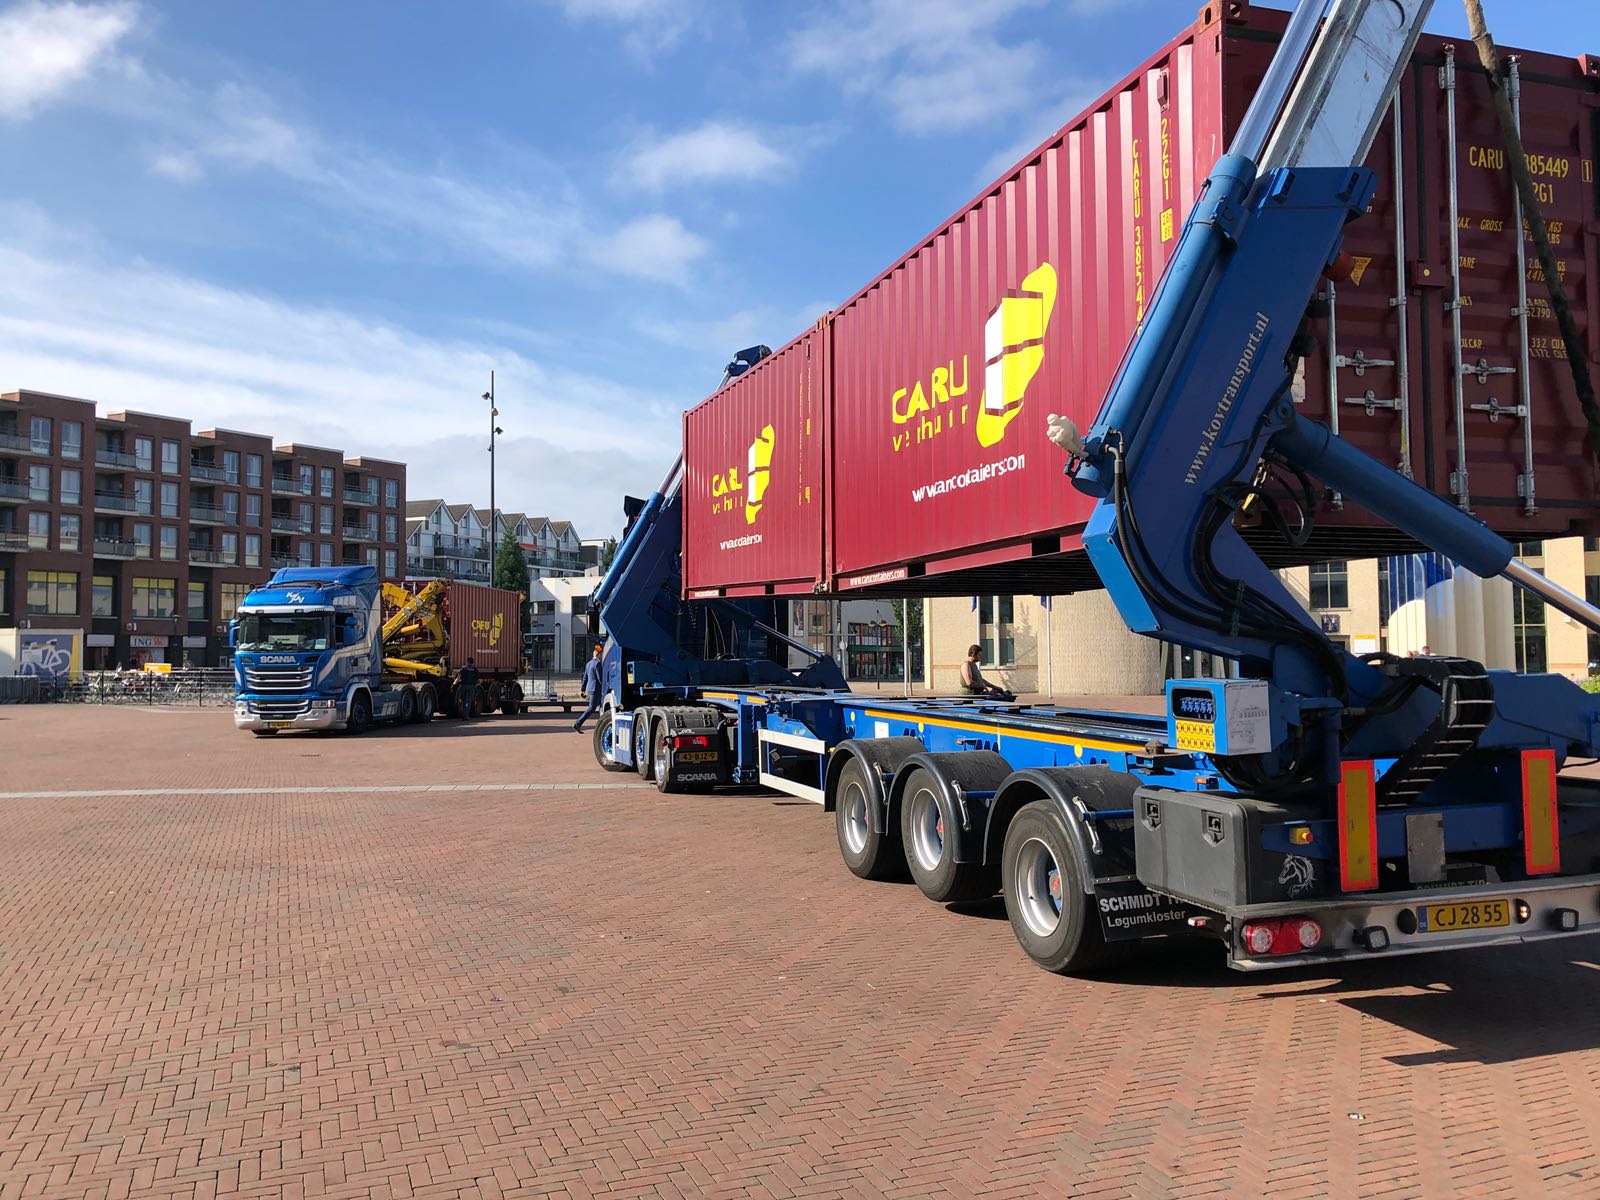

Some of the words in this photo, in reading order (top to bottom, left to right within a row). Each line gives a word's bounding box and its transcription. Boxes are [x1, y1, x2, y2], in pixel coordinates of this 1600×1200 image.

[1468, 146, 1504, 170] CARU
[1133, 138, 1142, 218] CARU
[1479, 219, 1504, 232] GROSS
[1548, 221, 1564, 233] KGS
[1556, 261, 1566, 272] GS
[892, 353, 968, 424] CARU
[1184, 311, 1270, 485] www.kovtransport.nl
[134, 637, 152, 646] ING
[260, 655, 296, 664] SCANIA
[677, 772, 718, 782] SCANIA
[1099, 893, 1161, 913] SCHMIDT
[1106, 909, 1187, 929] Løgumkloster
[1434, 907, 1457, 927] CJ
[1461, 905, 1480, 925] 28
[1484, 903, 1503, 922] 55
